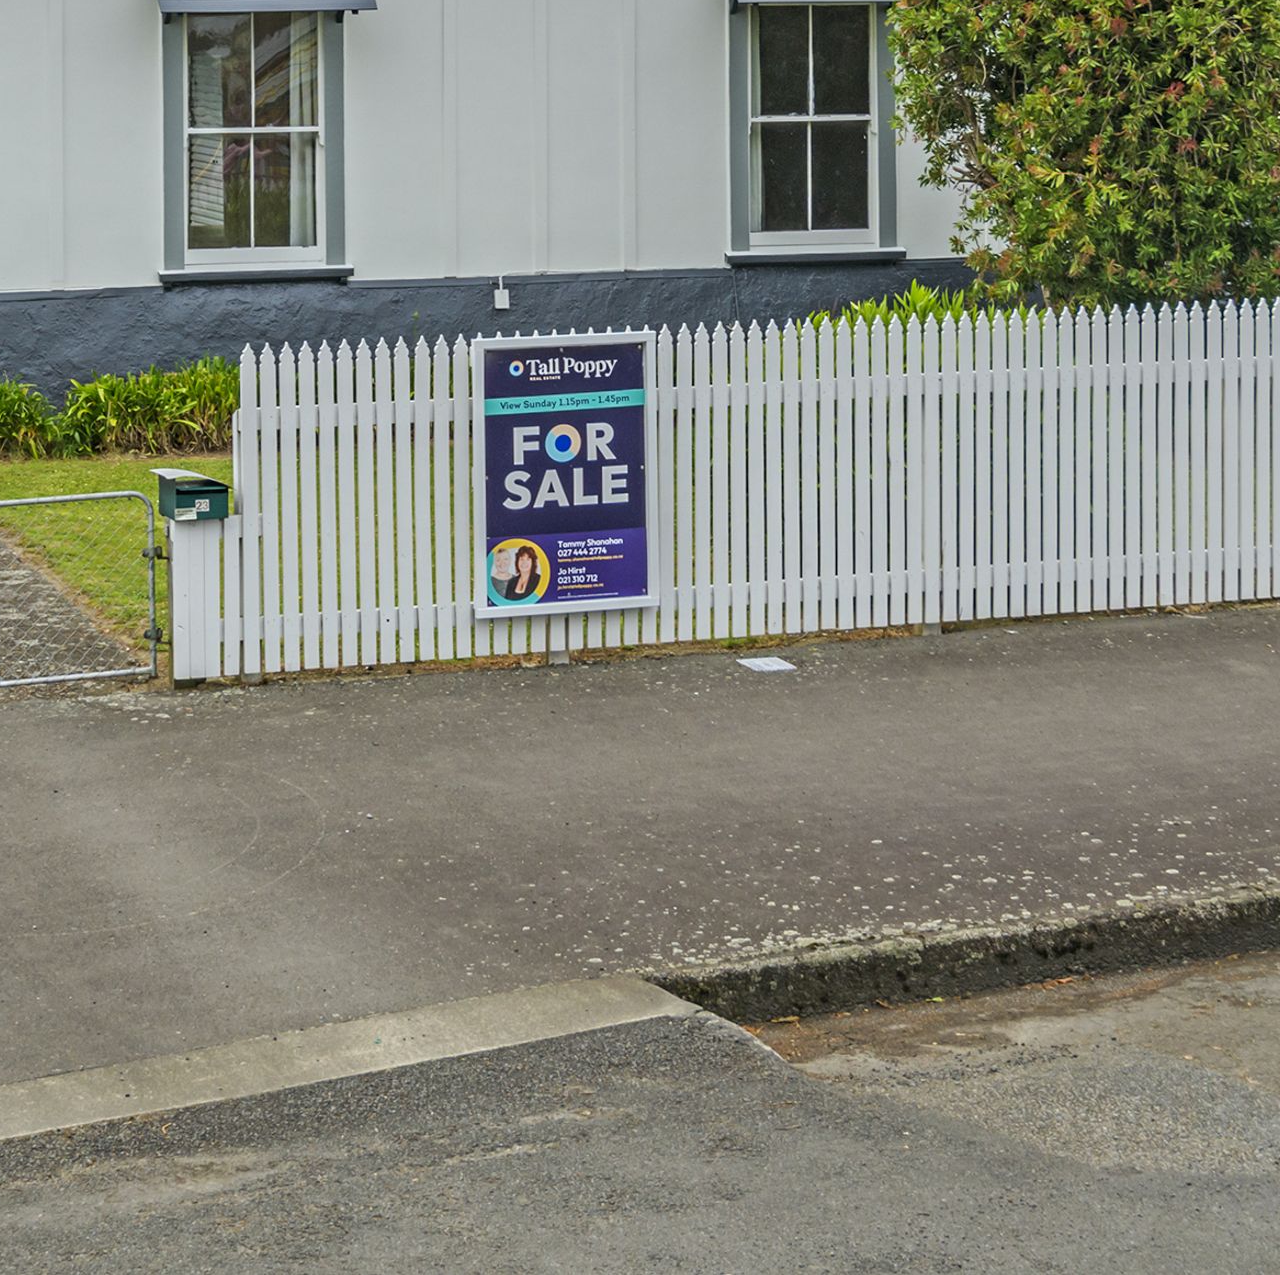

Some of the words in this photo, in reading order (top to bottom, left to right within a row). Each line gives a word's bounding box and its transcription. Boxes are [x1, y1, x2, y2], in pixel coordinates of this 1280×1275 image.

[525, 357, 561, 376] Tall
[563, 356, 618, 379] Poppy
[500, 401, 521, 410] View
[523, 399, 557, 409] Sunday
[559, 397, 590, 407] 1.15pm
[598, 394, 630, 404] 1.45pm
[513, 422, 617, 465] FOR
[502, 465, 629, 510] SALE
[196, 500, 209, 510] 23
[557, 549, 572, 557] 027
[573, 548, 588, 556] 444
[589, 547, 607, 555] 2774
[558, 567, 567, 575] Jo
[568, 566, 586, 574] Hirst
[557, 576, 571, 584] 021
[572, 574, 585, 583] 310
[586, 573, 598, 582] 712
